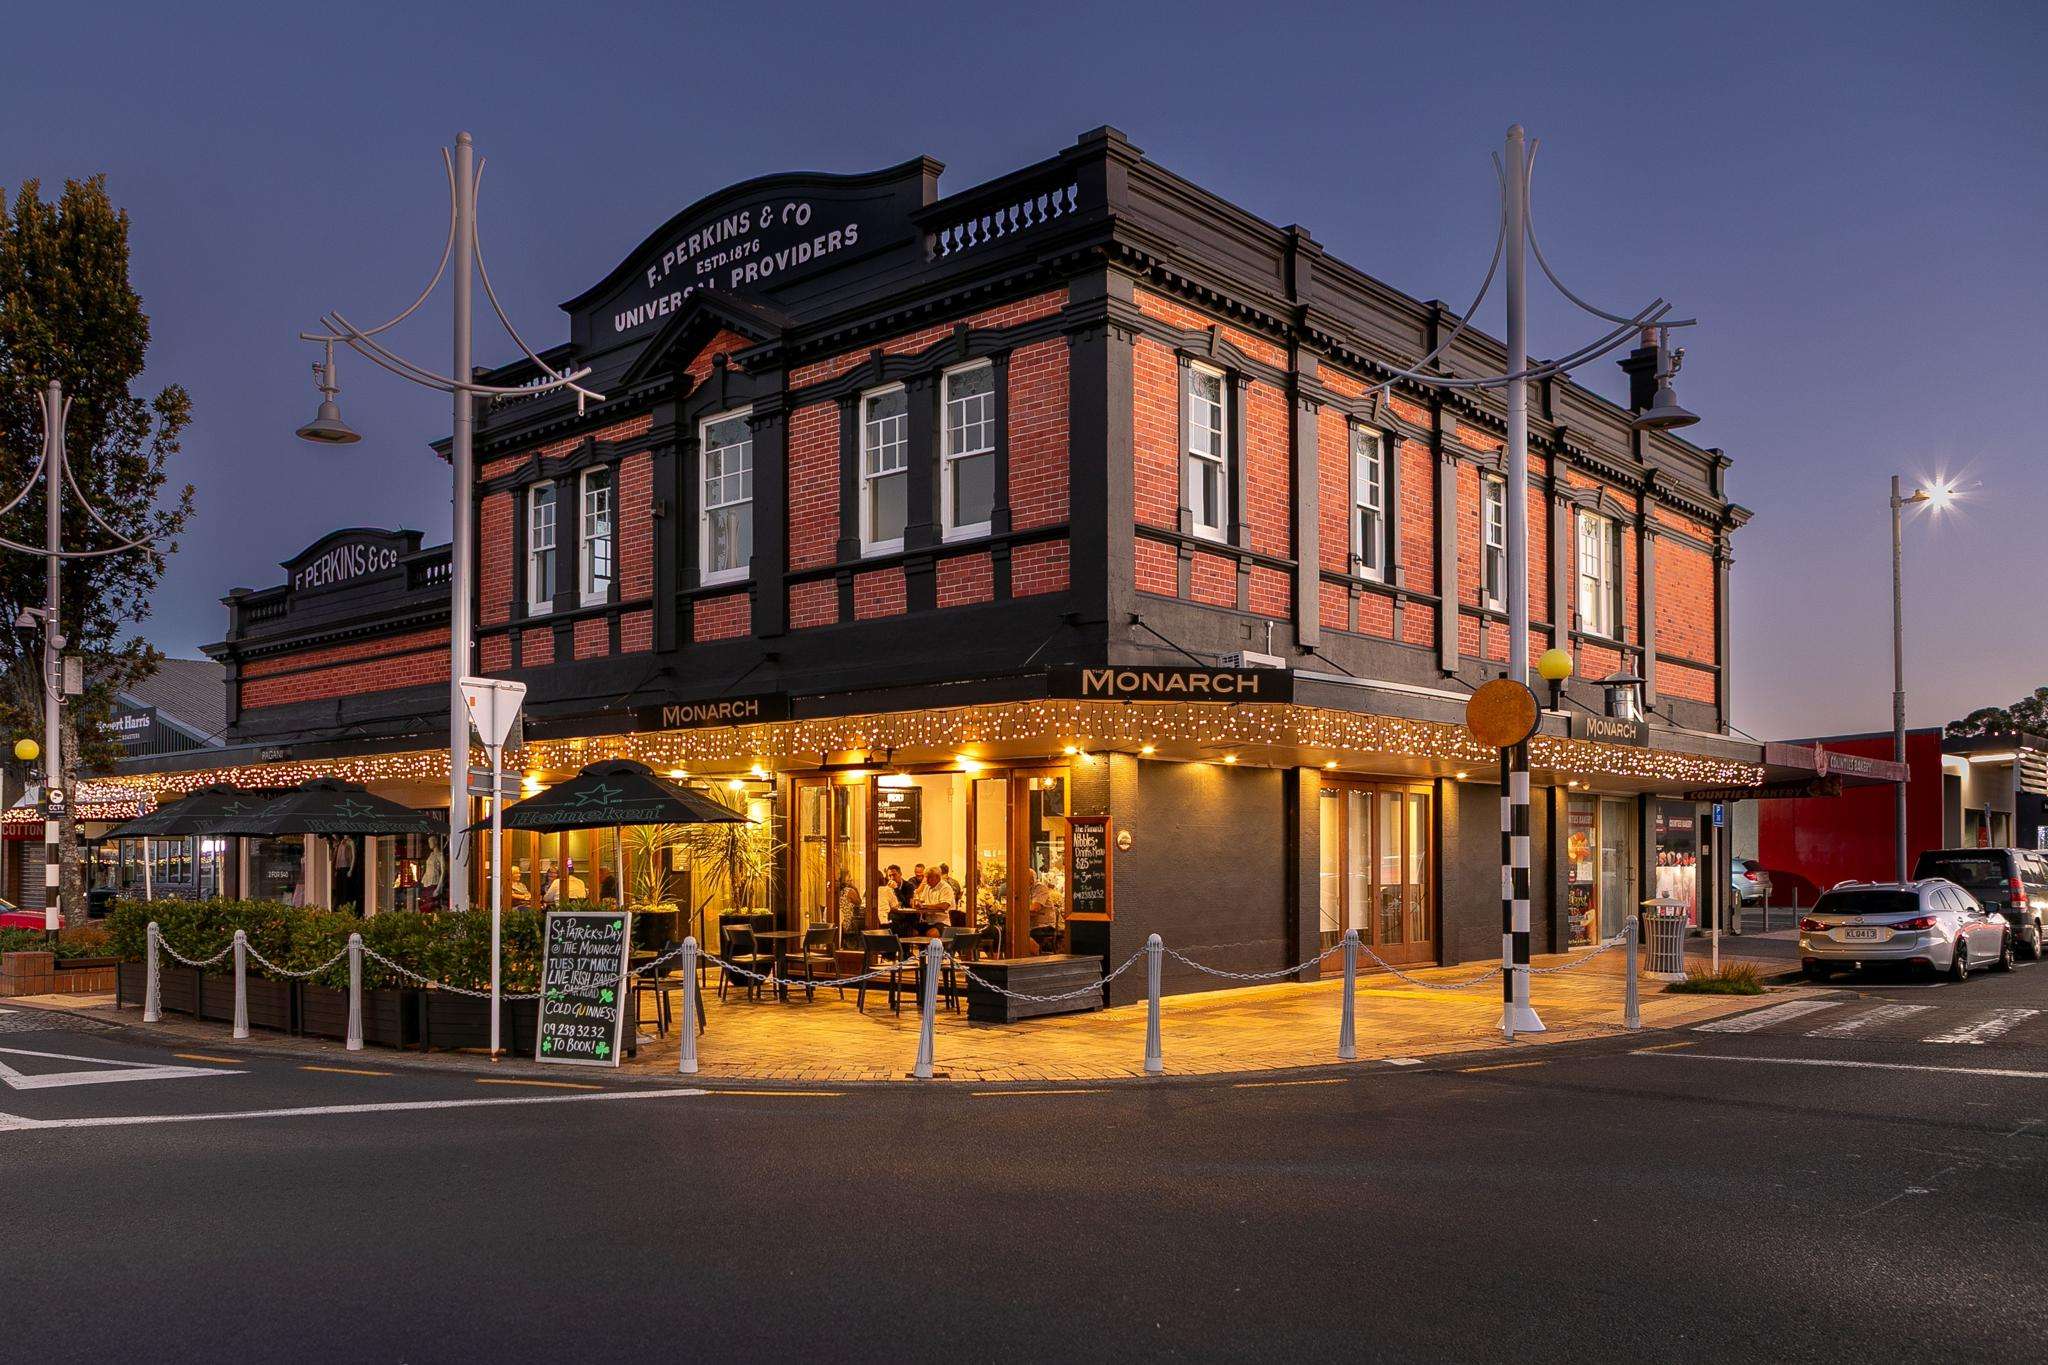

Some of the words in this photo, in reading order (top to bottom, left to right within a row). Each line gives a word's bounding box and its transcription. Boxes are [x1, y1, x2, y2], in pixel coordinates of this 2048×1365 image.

[663, 211, 750, 275] PERKINS
[760, 206, 773, 228] &
[731, 223, 858, 289] PROVIDERS
[306, 544, 365, 588] PERKINS
[368, 546, 378, 572] &
[1082, 669, 1259, 696] MONARCH
[124, 713, 150, 730] Harris
[663, 700, 758, 728] MONARCH
[1586, 718, 1637, 739] MONARCH
[1690, 789, 1749, 800] COUNTIES
[3, 824, 43, 836] COTTON
[562, 942, 578, 954] THE
[579, 940, 621, 956] MONARCH
[549, 958, 574, 970] TUES
[590, 958, 618, 972] MARCH
[548, 970, 570, 985] LIVE
[571, 970, 591, 985] IRISH
[545, 1000, 571, 1015] COLD
[572, 1002, 616, 1022] GUINNESS
[544, 1023, 556, 1035] 09
[557, 1023, 576, 1036] 238
[577, 1025, 605, 1038] 3232
[552, 1038, 565, 1051] TO
[567, 1038, 596, 1053] BOOK!
